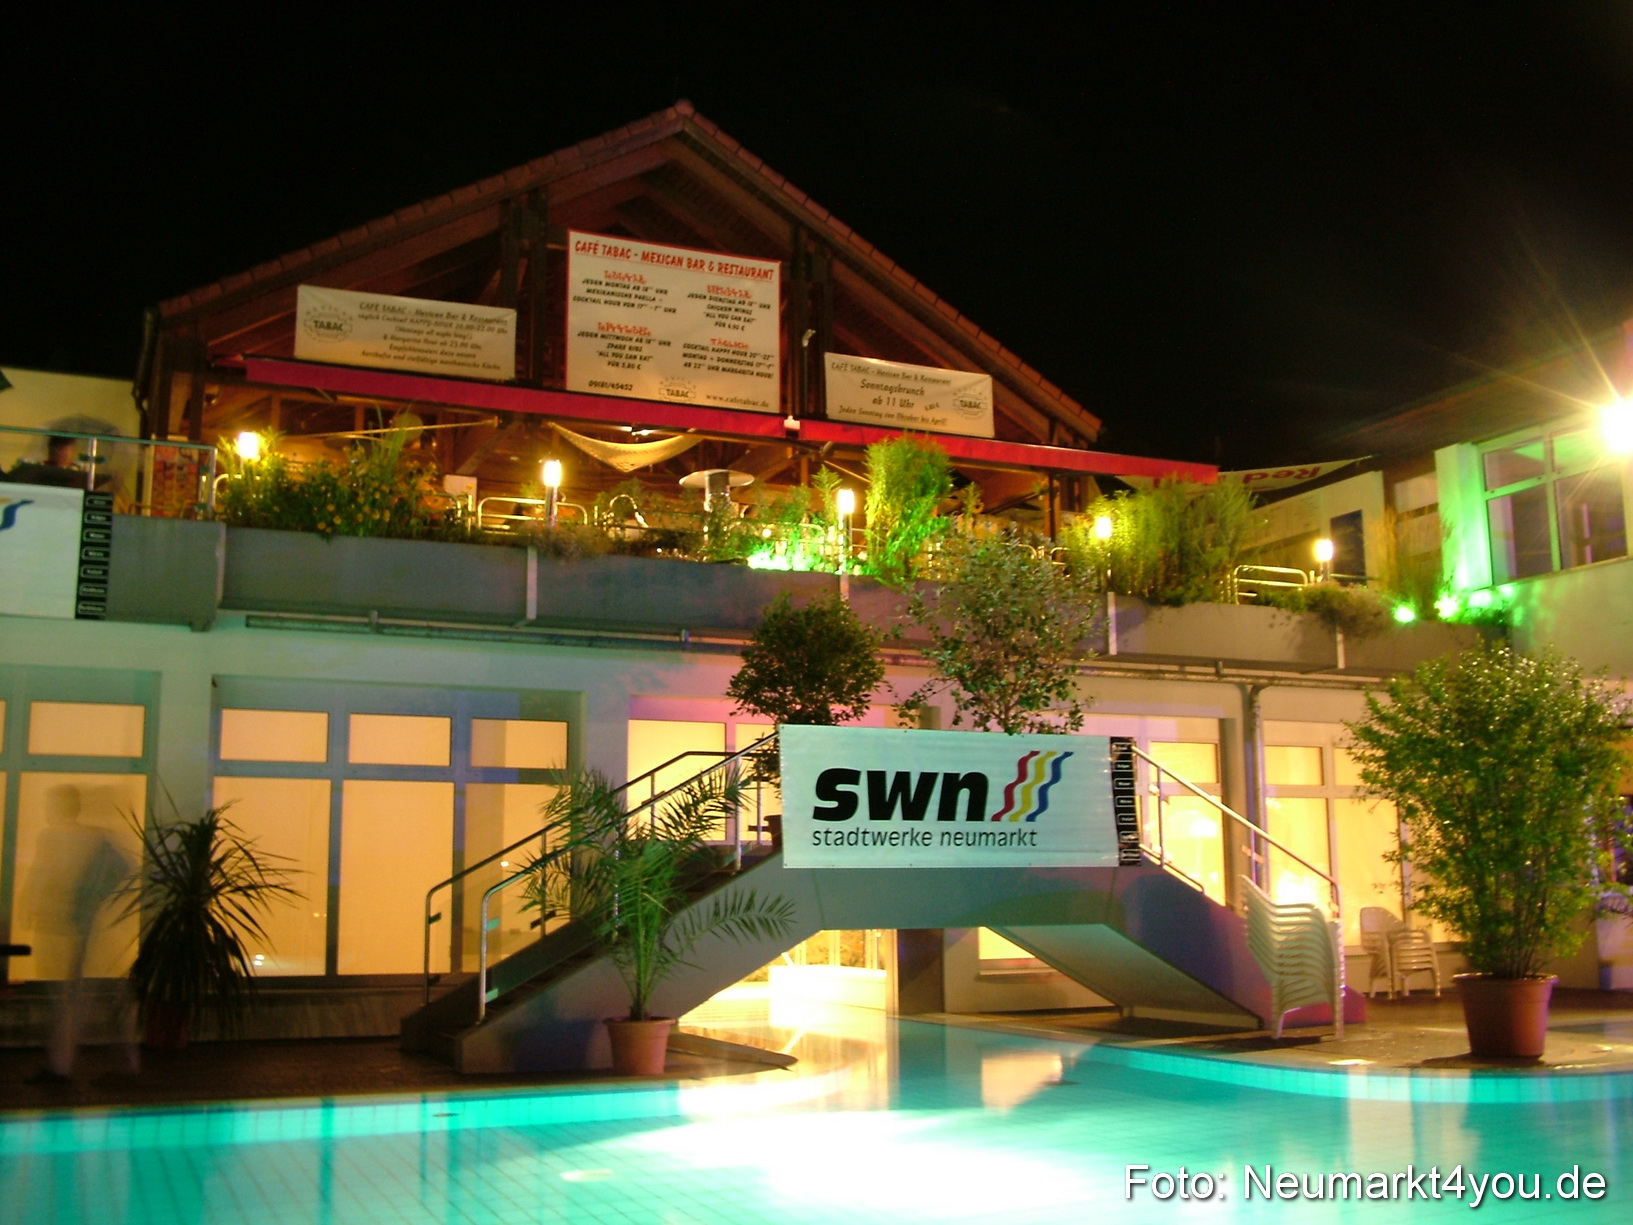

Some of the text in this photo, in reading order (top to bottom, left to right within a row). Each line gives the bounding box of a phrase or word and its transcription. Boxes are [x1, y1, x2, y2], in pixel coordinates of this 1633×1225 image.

[575, 240, 599, 255] CAFÉ
[602, 244, 632, 259] TABAC
[641, 250, 684, 267] MEXICAN
[687, 257, 706, 271] BAR
[708, 260, 715, 272] &
[717, 262, 775, 280] RESTAURANT
[313, 319, 344, 332] TABAC
[611, 351, 625, 359] YOU
[666, 388, 690, 398] TABAC
[860, 378, 926, 397] Sonntagsbrunch
[872, 395, 883, 405] ab
[886, 396, 897, 406] 11
[899, 398, 915, 408] Uhr
[959, 399, 982, 409] TABAC
[812, 767, 989, 822] swn
[812, 826, 1038, 848] stadtwerke neumarkt
